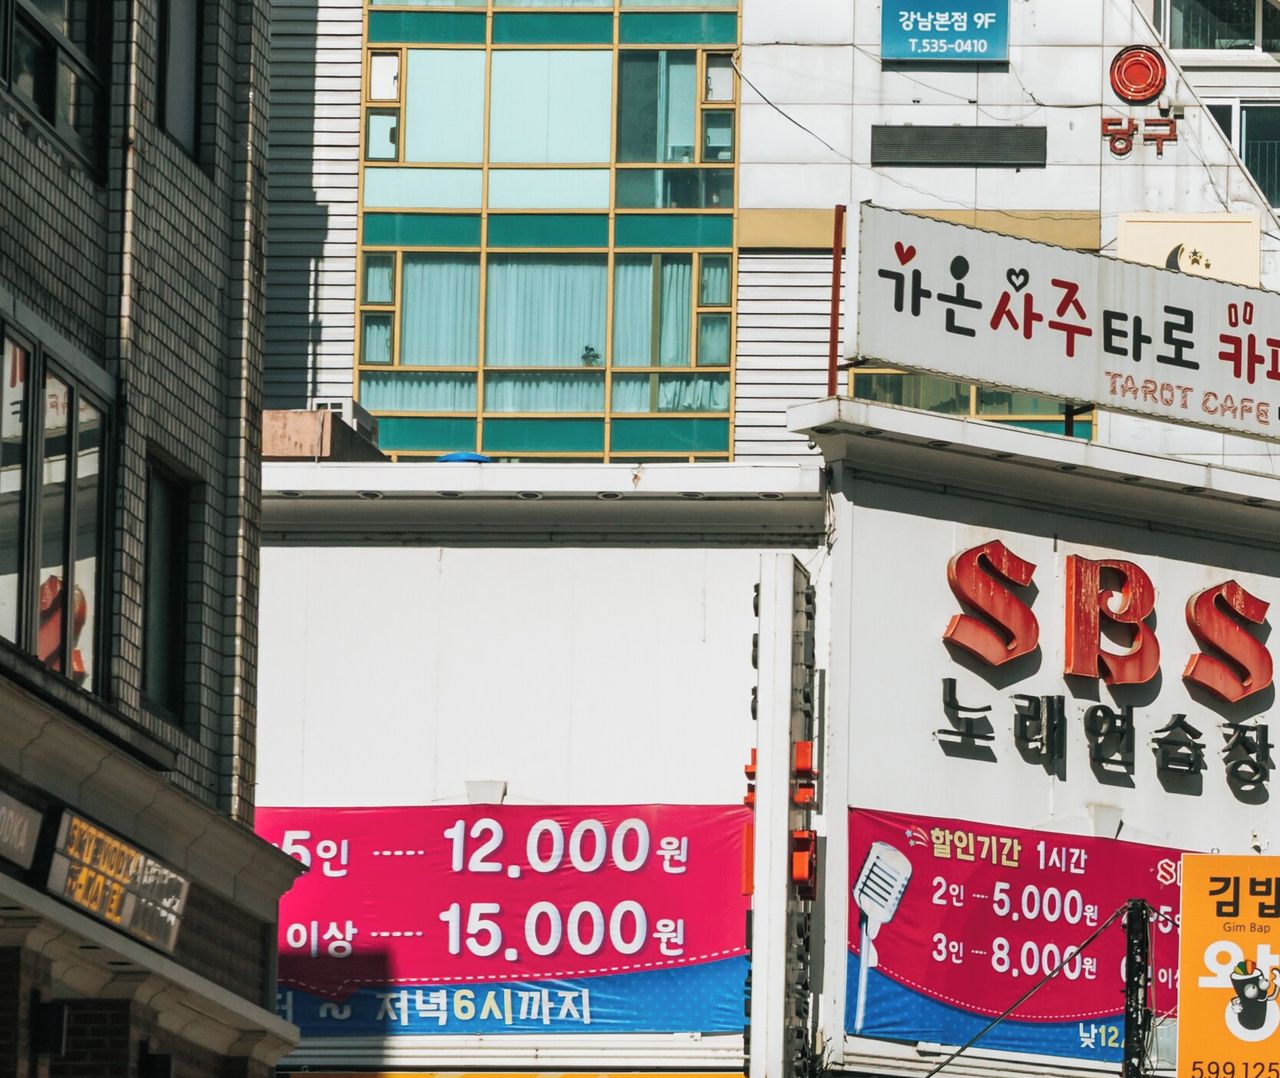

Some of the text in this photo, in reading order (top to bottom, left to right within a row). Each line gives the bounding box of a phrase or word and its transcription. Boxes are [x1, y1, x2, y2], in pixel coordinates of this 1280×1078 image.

[898, 10, 996, 31] 강남본점 9F
[908, 39, 988, 54] T.535-0410
[1102, 118, 1178, 159] 당구
[1104, 370, 1193, 410] TAROT
[1202, 390, 1270, 426] CAFE
[942, 538, 1274, 703] SBS
[933, 678, 1276, 785] 노래연습장
[443, 818, 688, 879] 12.000원
[930, 827, 1088, 875] 할인기간 1시간
[932, 877, 964, 908] 2인
[992, 881, 1099, 927] 5.000원
[287, 901, 685, 962] 이상 15.000원
[1223, 922, 1271, 934] Gim Bap
[932, 932, 1098, 982] 3인 8.000원
[375, 987, 591, 1026] 저녁6시까지
